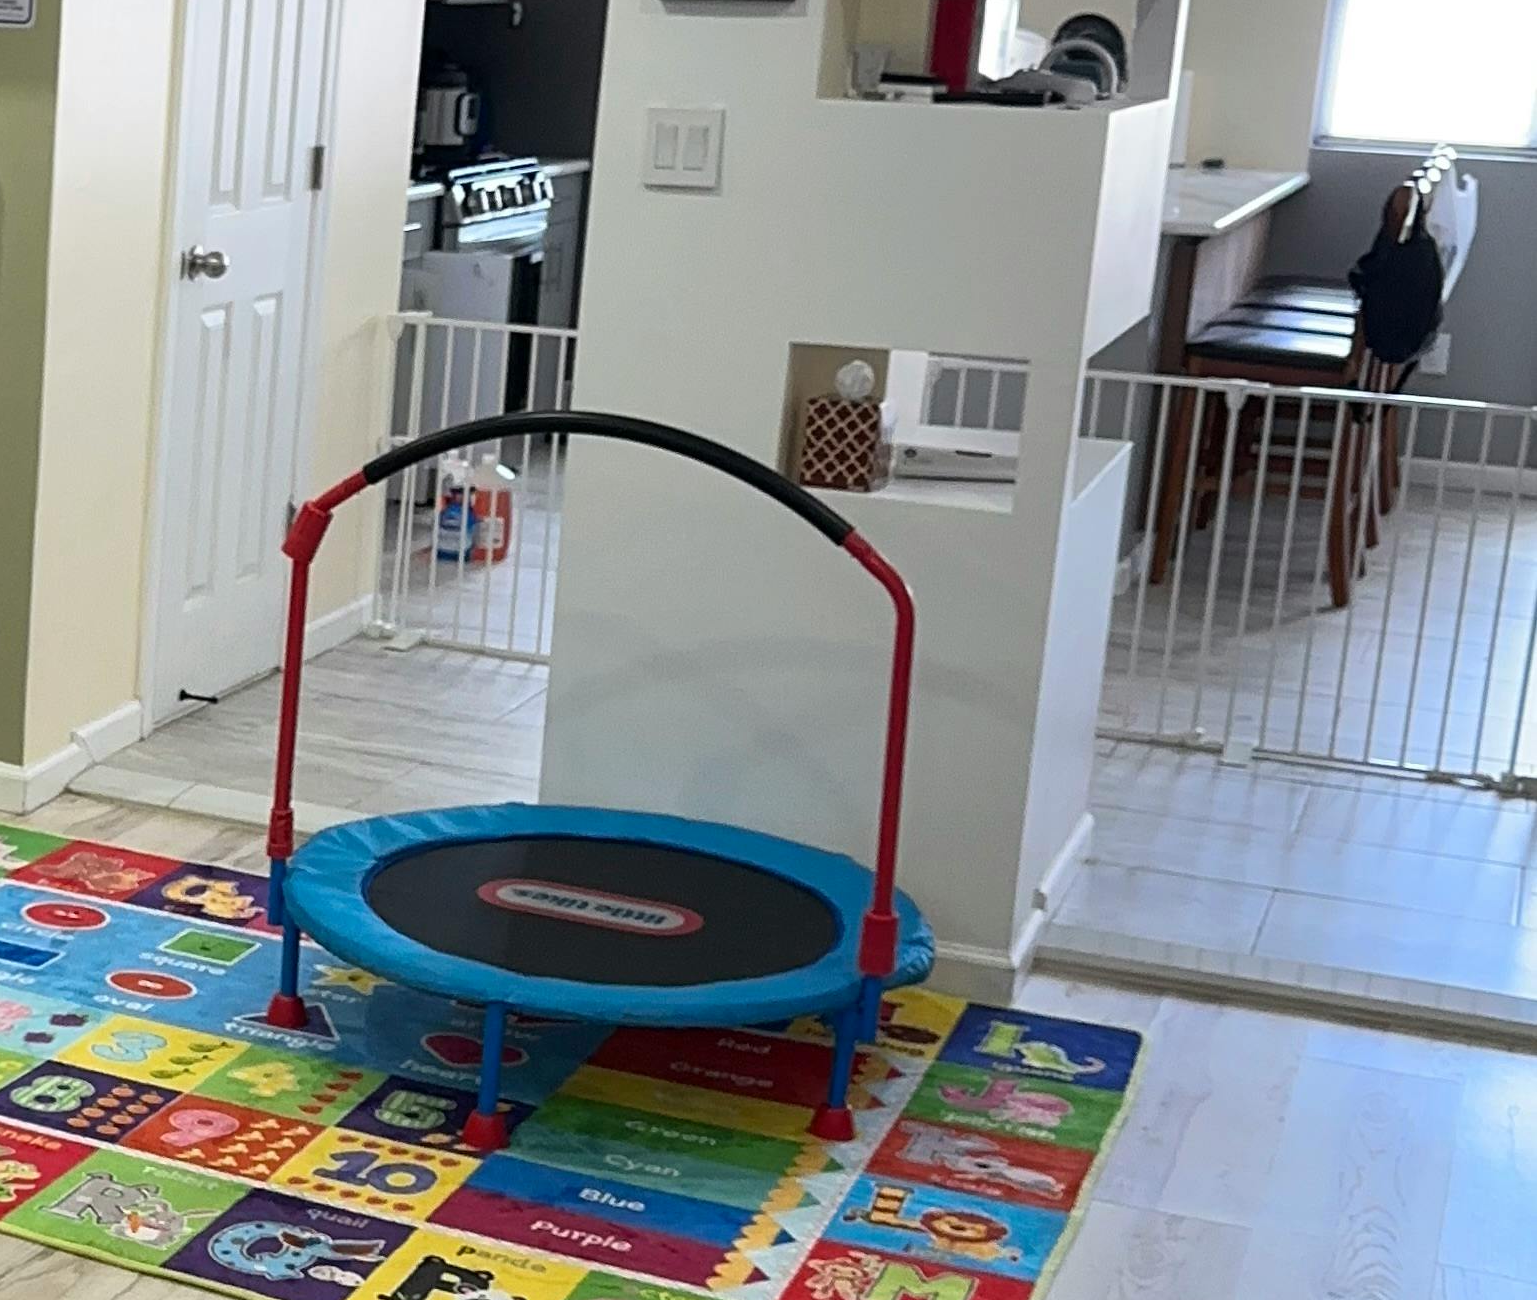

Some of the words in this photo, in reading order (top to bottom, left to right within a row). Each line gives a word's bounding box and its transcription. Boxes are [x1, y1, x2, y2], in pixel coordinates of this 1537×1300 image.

[138, 951, 228, 976] square
[92, 994, 155, 1014] oval
[90, 1030, 168, 1064] 3
[9, 1074, 97, 1114] 8
[373, 1089, 458, 1131] 5
[159, 1108, 242, 1148] 9
[311, 1150, 439, 1197] 10
[603, 1152, 682, 1179] Cyan
[578, 1186, 648, 1213] Blue
[306, 1206, 370, 1230] quail
[529, 1219, 635, 1254] Purple
[455, 1243, 549, 1275] panda
